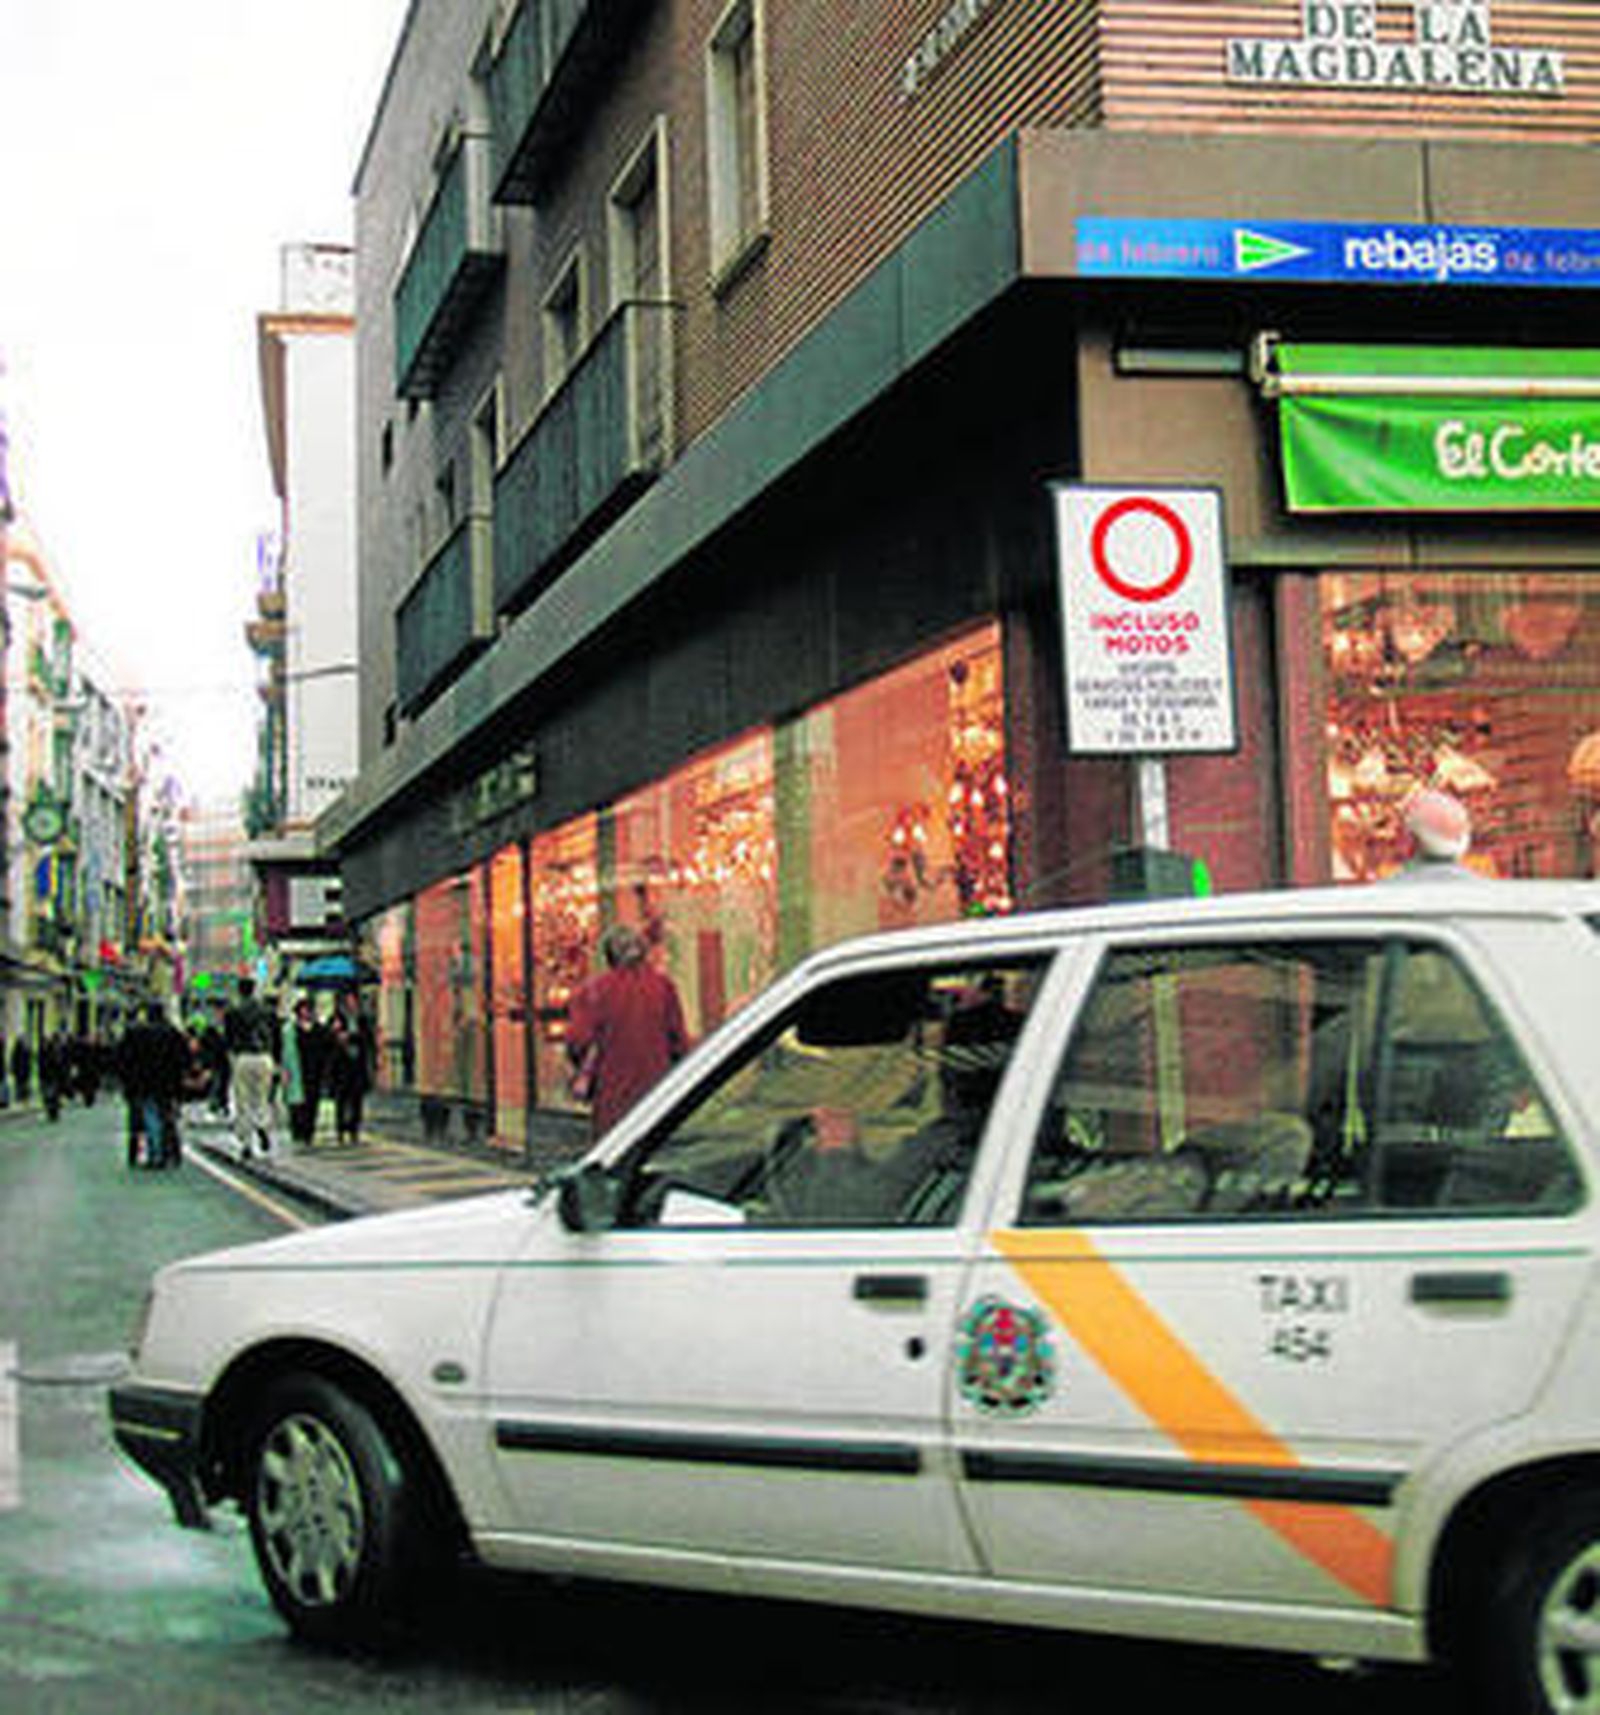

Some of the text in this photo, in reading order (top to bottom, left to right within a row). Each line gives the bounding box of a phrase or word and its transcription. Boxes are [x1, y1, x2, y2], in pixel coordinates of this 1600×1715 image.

[1306, 2, 1487, 44] DE LA
[1232, 40, 1560, 88] MAGDALENA
[1344, 229, 1497, 282] rebajas
[1435, 420, 1488, 478] El
[1089, 611, 1200, 632] INCLUSO
[1105, 634, 1190, 655] MOTOS
[1259, 1275, 1348, 1314] TAXI
